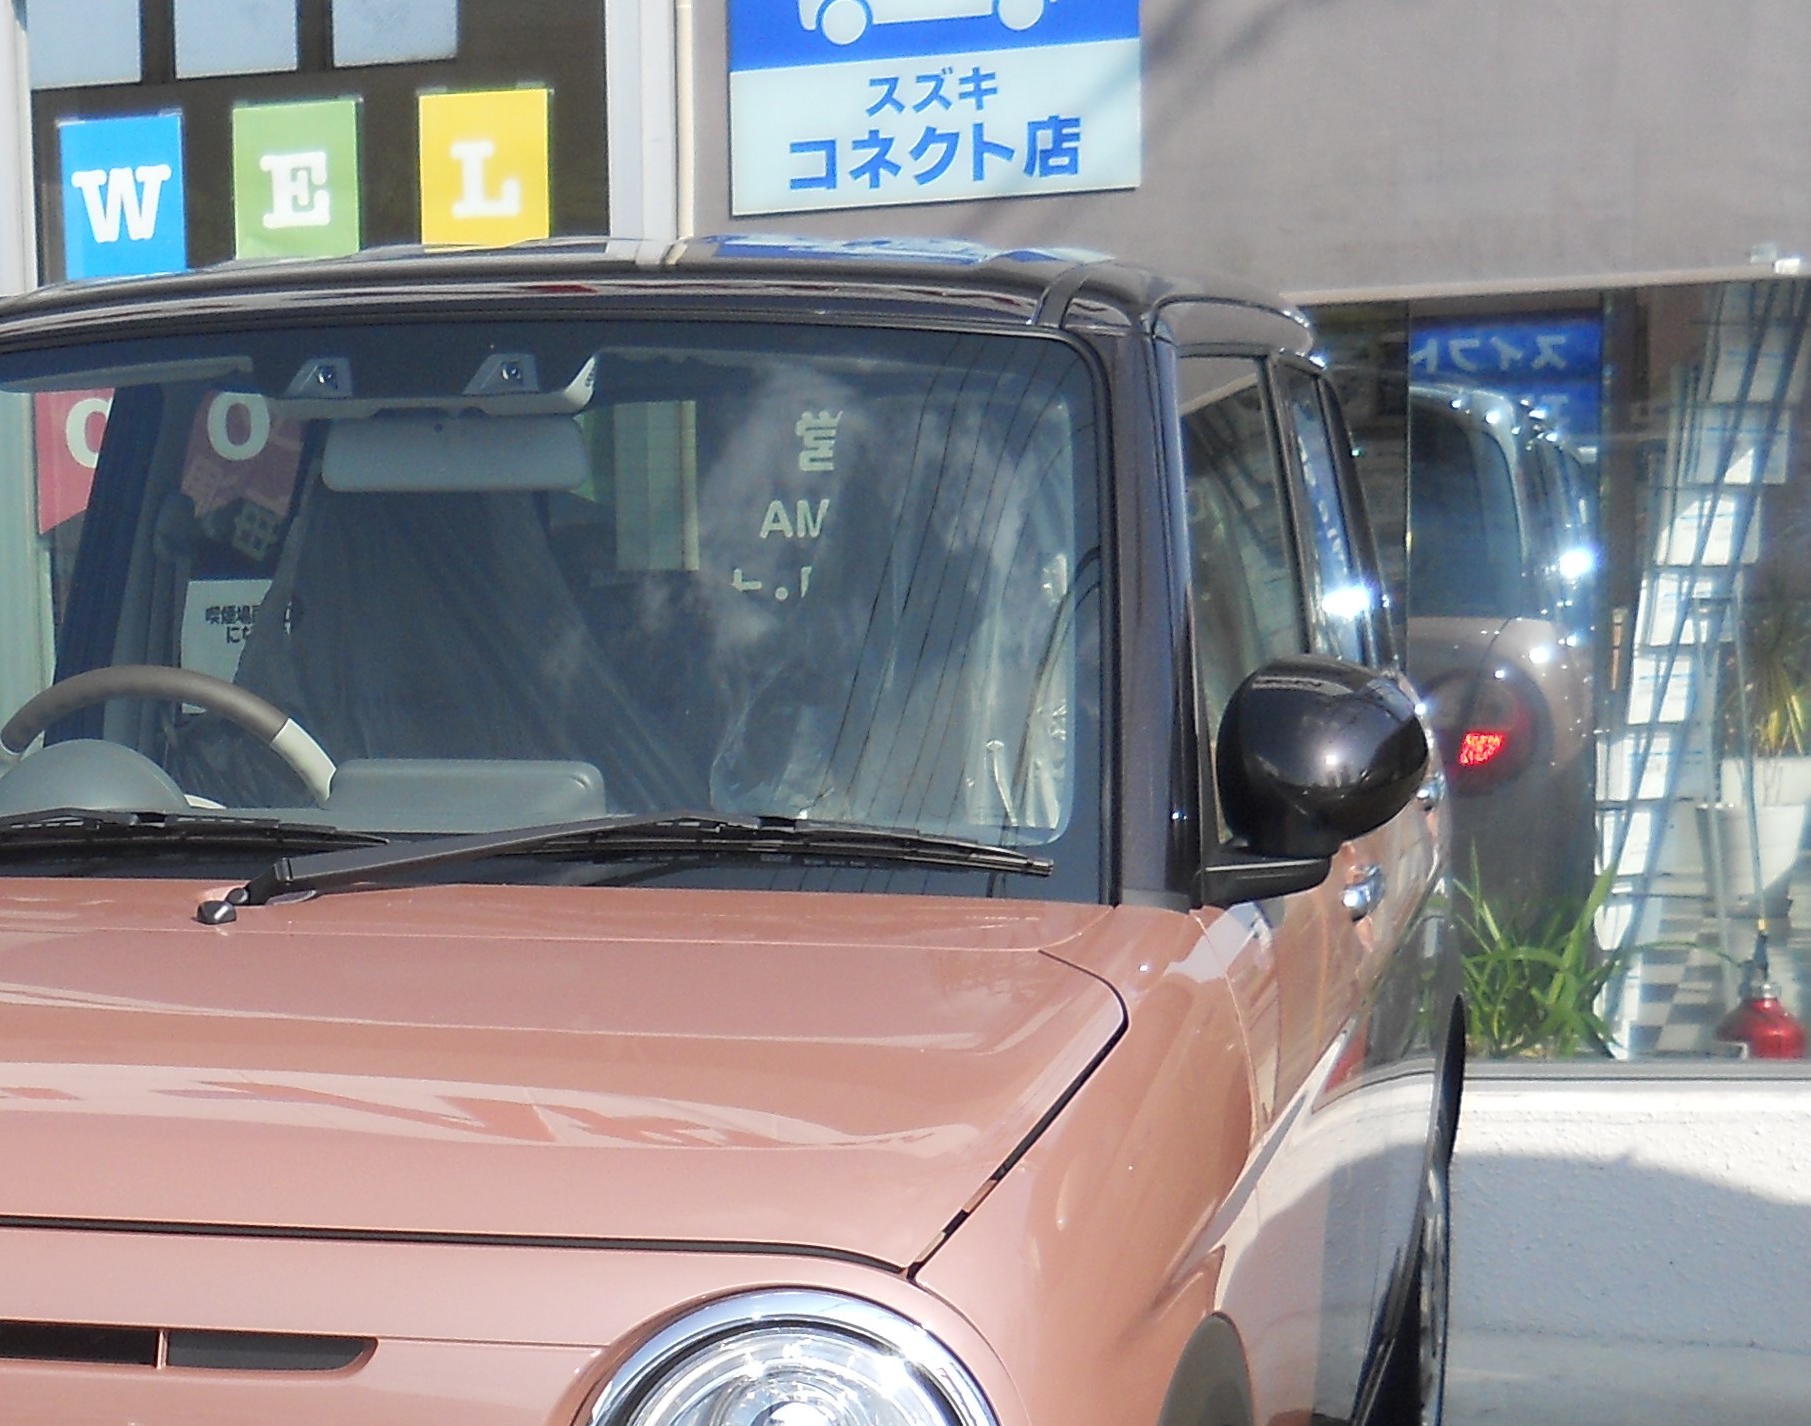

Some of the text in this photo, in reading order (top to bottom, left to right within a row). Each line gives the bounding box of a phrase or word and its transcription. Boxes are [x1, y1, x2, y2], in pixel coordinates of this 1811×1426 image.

[865, 66, 998, 117] スズキ
[788, 114, 1082, 191] コネクト店
[71, 140, 521, 243] W E L
